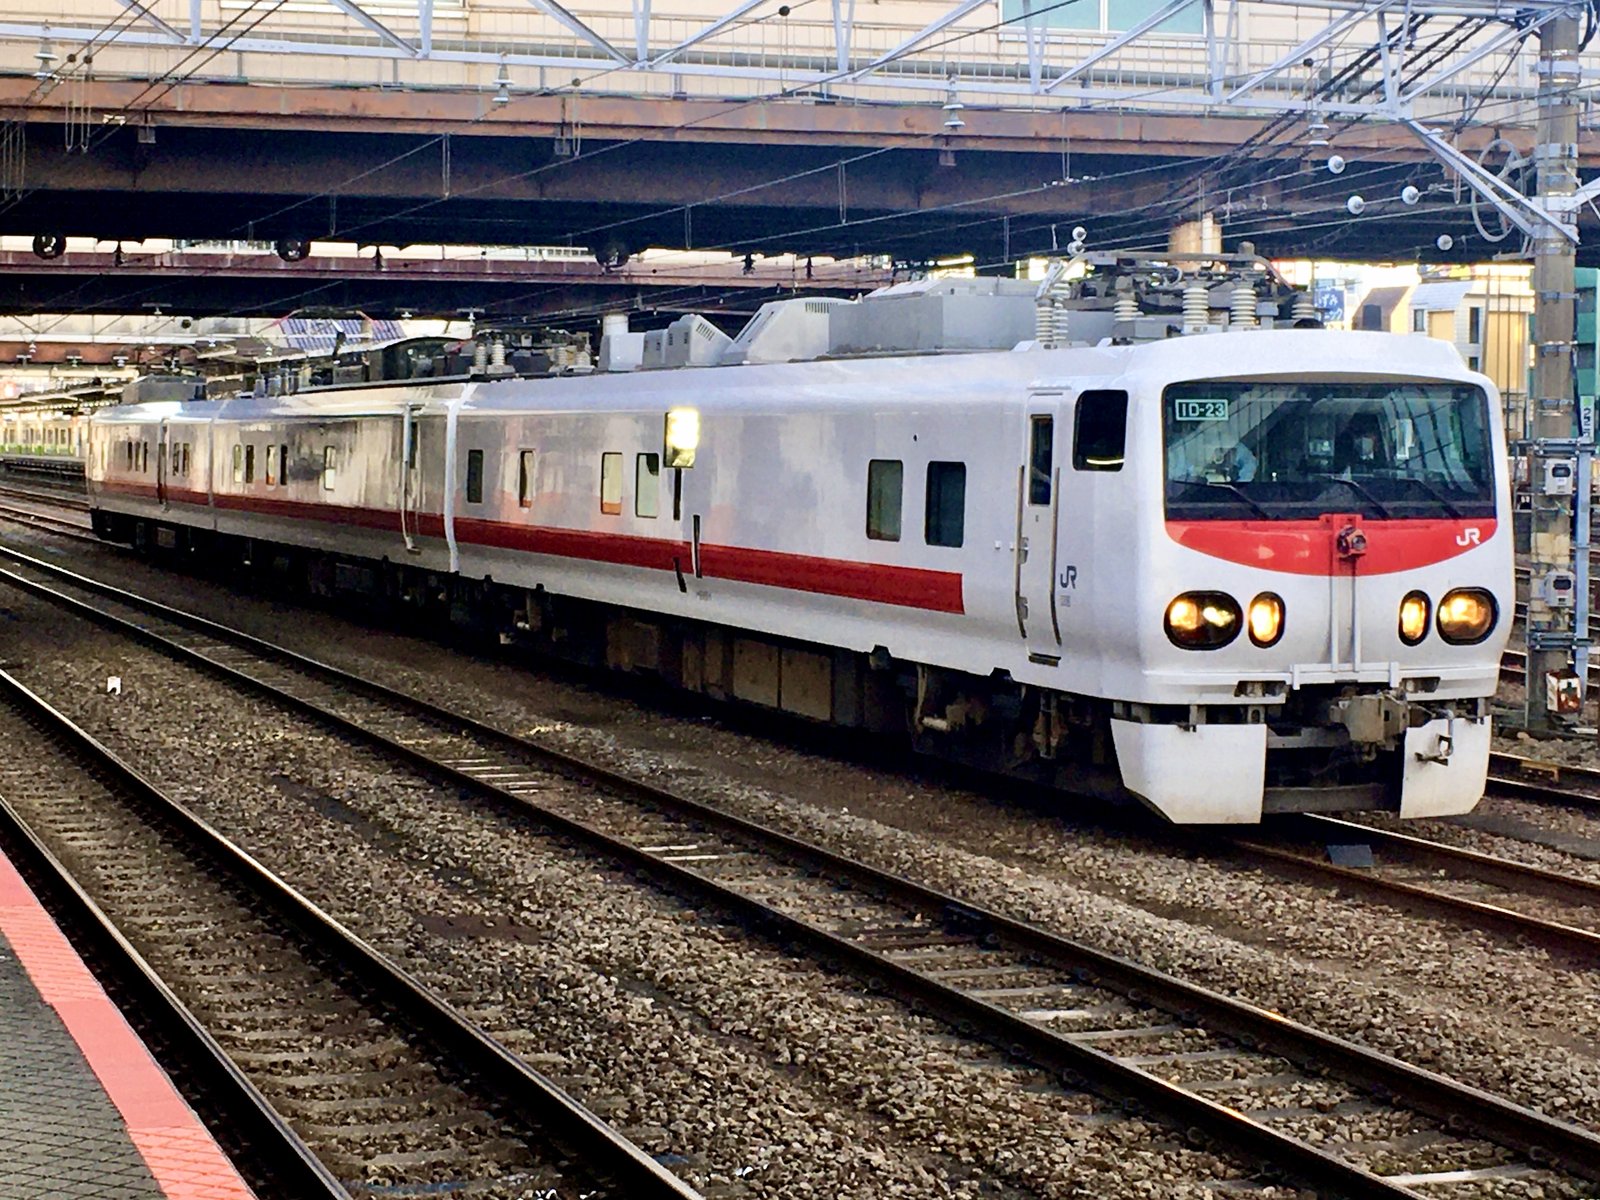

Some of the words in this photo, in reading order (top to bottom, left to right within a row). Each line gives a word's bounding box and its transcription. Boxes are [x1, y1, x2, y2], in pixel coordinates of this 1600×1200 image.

[1182, 403, 1225, 417] ID-23
[1456, 528, 1480, 546] JR
[1060, 565, 1078, 590] JR
